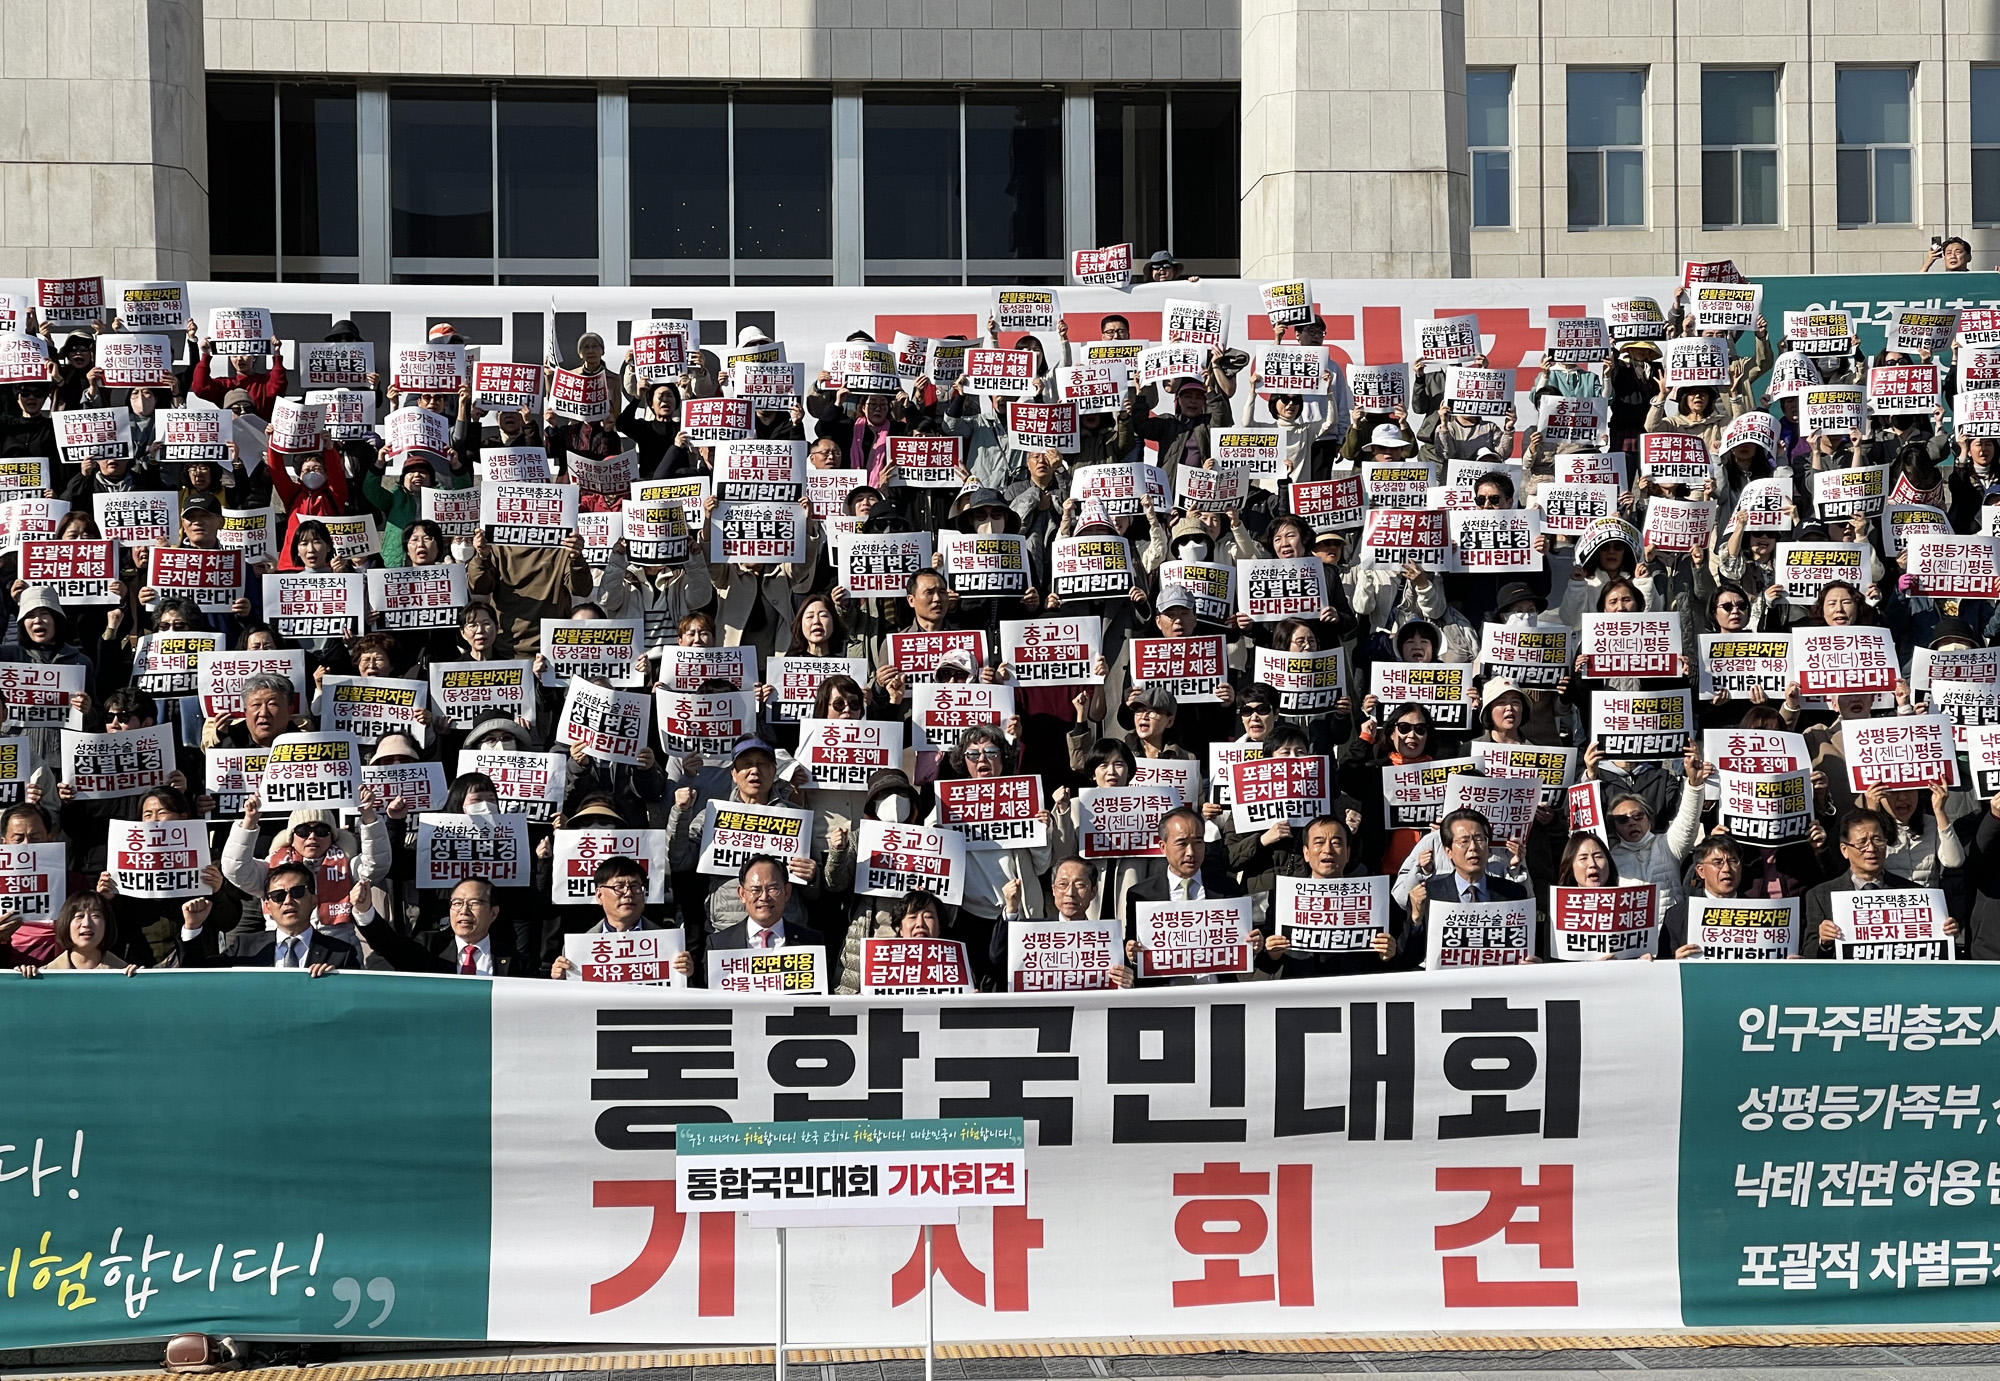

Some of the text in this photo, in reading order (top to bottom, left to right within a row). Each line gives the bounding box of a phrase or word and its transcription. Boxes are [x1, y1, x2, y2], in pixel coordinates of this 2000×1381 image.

[1109, 246, 1126, 258] 차별
[1080, 258, 1127, 273] 금지법 제정
[1082, 272, 1130, 285] 반대한다!
[1001, 292, 1051, 303] 생활동반자법
[1700, 290, 1754, 300] 생활동반자법
[999, 303, 1053, 313] (동성결합 허용)
[1736, 301, 1754, 311] 허용)
[1001, 316, 1052, 327] 반대한다!
[1700, 312, 1752, 326] 반대한다!
[104, 344, 162, 354] 성평등가족부
[310, 350, 348, 359] 성전환수술
[975, 351, 1028, 364] 포괄적 차별
[105, 357, 163, 368] 성(젠더)평등
[310, 359, 366, 372] 성별변경
[971, 364, 1027, 376] 금지법 제정
[974, 378, 1028, 390] 반대한다!
[730, 444, 792, 455] 인구주택총조사
[1650, 437, 1681, 449] 포괄적
[1649, 450, 1705, 462] 금지법 제정
[729, 468, 790, 480] 배우자 등록
[1651, 464, 1708, 478] 반대한다!
[724, 483, 796, 500] 반대한다!
[724, 509, 793, 520] 성전환수술 없는
[723, 522, 794, 539] 성별변경
[1462, 520, 1528, 530] 성전환수술 없는
[1461, 531, 1529, 547] 성별변경
[722, 541, 794, 556] 반대한다!
[1461, 550, 1530, 566] 반대한다!
[1023, 623, 1079, 645] 종교의
[1594, 622, 1670, 636] 성평등가족부
[1024, 646, 1080, 659] 자유 침해
[1594, 638, 1670, 652] 성(젠더)평등
[1711, 642, 1788, 658] 생활동반자법
[1016, 661, 1090, 680] 반대한다!
[1594, 654, 1670, 672] 반대한다!
[1710, 660, 1788, 673] (동성결합 허용)
[1713, 676, 1785, 692] 반대한다!
[576, 690, 640, 718] 성전환수술 없는
[1604, 698, 1683, 714] 낙태 전면 허용
[570, 701, 640, 738] 성별변경
[1604, 716, 1683, 731] 약물 낙태 허용
[75, 738, 158, 755] 성전환수술 없는
[568, 722, 638, 757] 반대한다!
[1605, 735, 1683, 754] 반대한다!
[271, 742, 350, 761] 생활동반자법
[75, 752, 160, 775] 성별변경
[266, 761, 352, 780] (동성결합 허용)
[75, 770, 164, 792] 반대한다!
[267, 780, 352, 802] 반대한다!
[949, 781, 1030, 801] 포괄적 차별
[949, 800, 1031, 820] 금지법 제정
[433, 824, 514, 839] 성전환수술 없는
[718, 810, 802, 837] 생활동반자법
[126, 825, 188, 852] 종교의
[713, 829, 799, 854] (동성결합 허용)
[881, 826, 943, 856] 종교의
[432, 840, 516, 860] 성별변경
[126, 851, 189, 868] 자유 침해
[880, 852, 942, 874] 자유 침해
[431, 862, 516, 880] 반대한다!
[120, 871, 199, 891] 반대한다!
[868, 870, 950, 897] 반대한다!
[1296, 882, 1372, 895] 인구주택총조사
[1296, 896, 1371, 911] 동성 파트너
[1565, 890, 1649, 910] 포괄적 차별
[1852, 894, 1930, 909] 인구주택총조사
[1150, 908, 1240, 928] 성평등가족부
[1296, 912, 1370, 926] 배우자 등록
[1445, 912, 1527, 927] 성전환수술 없는
[1564, 908, 1648, 930] 금지법 제정
[1704, 908, 1791, 927] 생활동반자법
[1854, 908, 1932, 924] 동성 파트너
[1022, 931, 1112, 950] 성평등가족부
[1151, 927, 1239, 948] 성(젠더)평등
[1291, 927, 1376, 949] 반대한다!
[1442, 927, 1527, 948] 성별변경
[1702, 928, 1791, 944] (동성결합 허용)
[1855, 925, 1932, 940] 배우자 등록
[1566, 931, 1648, 953] 반대한다!
[721, 954, 813, 975] 낙태 전면 허용
[1022, 950, 1112, 969] 성(젠더)평등
[1152, 946, 1239, 969] 반대한다!
[1441, 949, 1528, 966] 반대한다!
[721, 973, 813, 993] 약물 낙태 허용
[1023, 970, 1110, 990] 반대한다!
[590, 998, 1581, 1150] 통합국민대회
[1737, 1084, 1988, 1134] 성평등가족부,
[709, 1134, 741, 1144] 자녀가
[801, 1130, 820, 1145] 한국
[910, 1128, 956, 1143] 대한민국이
[687, 1162, 1015, 1201] 통합국민대회 기자회견
[1735, 1159, 1981, 1208] 낙태 전면 허용
[1738, 1240, 2000, 1290] 포괄적 차별금
